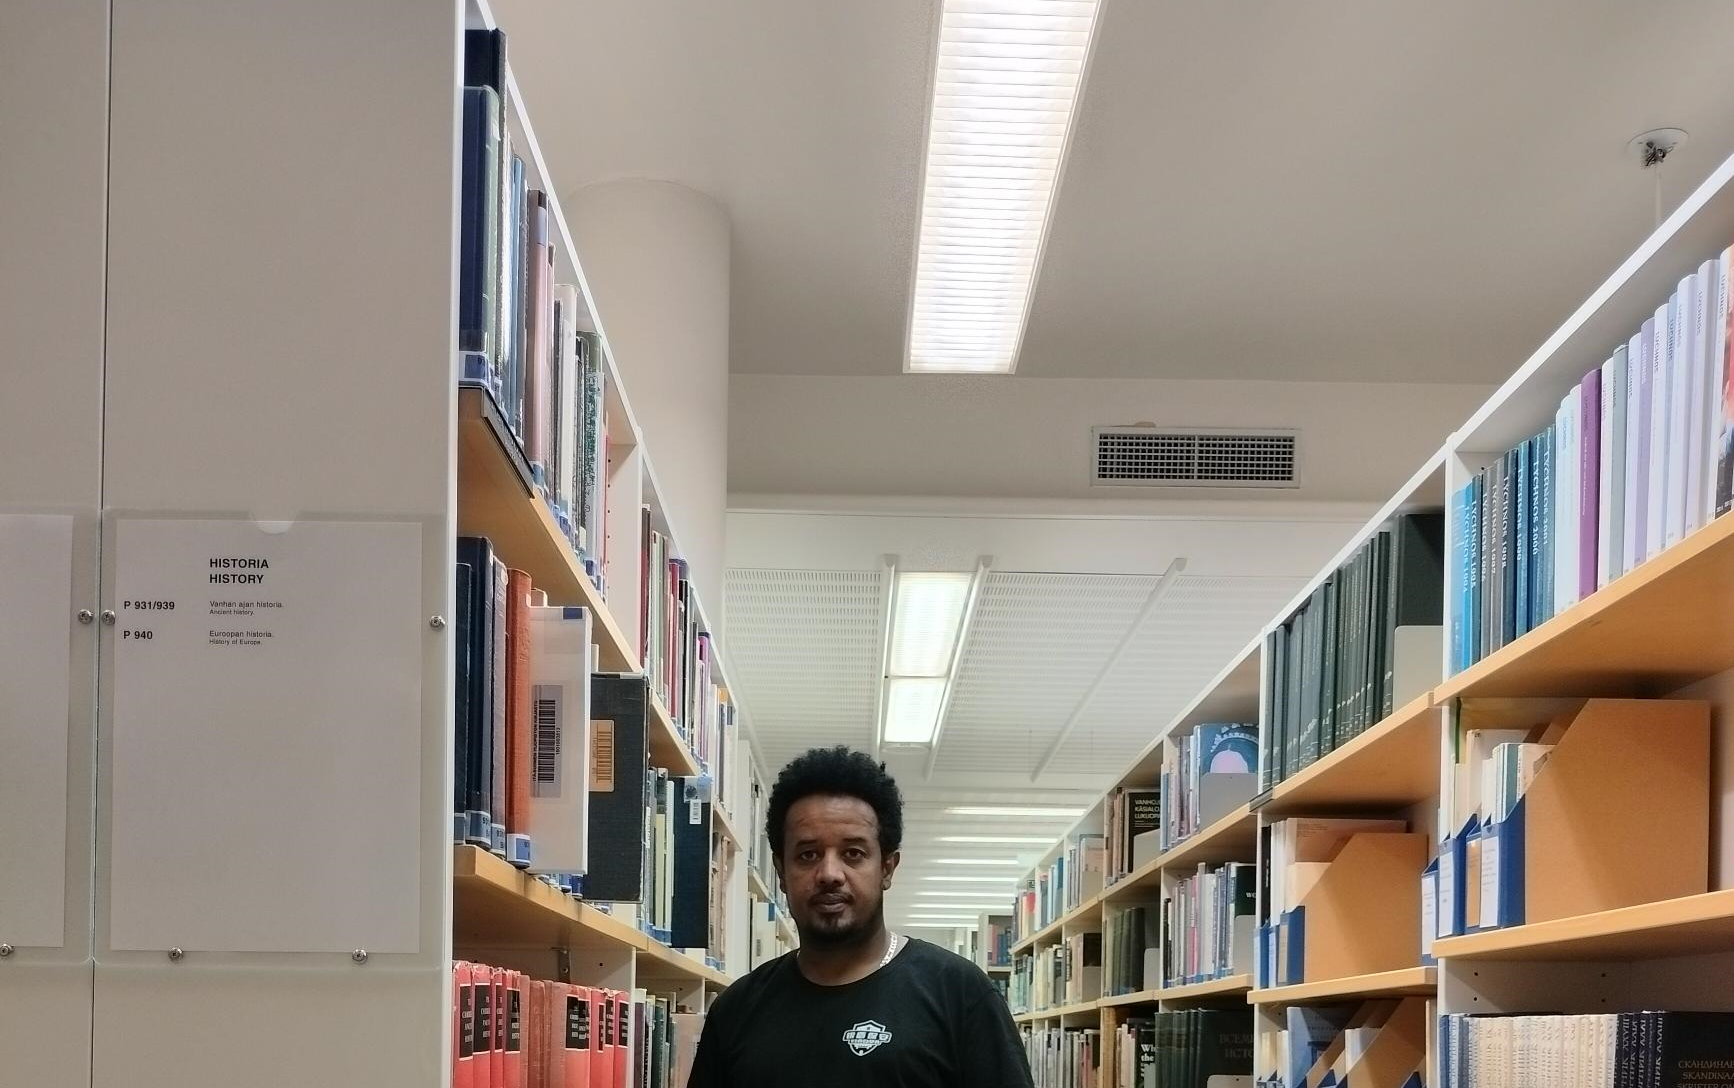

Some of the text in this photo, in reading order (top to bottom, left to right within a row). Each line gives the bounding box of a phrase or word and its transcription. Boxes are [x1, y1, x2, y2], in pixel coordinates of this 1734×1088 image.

[209, 558, 269, 569] HISTORIA
[209, 573, 264, 584] HISTORY
[124, 600, 175, 611] P 931/939
[210, 601, 237, 609] Vanhan
[239, 601, 254, 610] ajan
[123, 630, 153, 640] P 940
[209, 630, 244, 639] Euroopan
